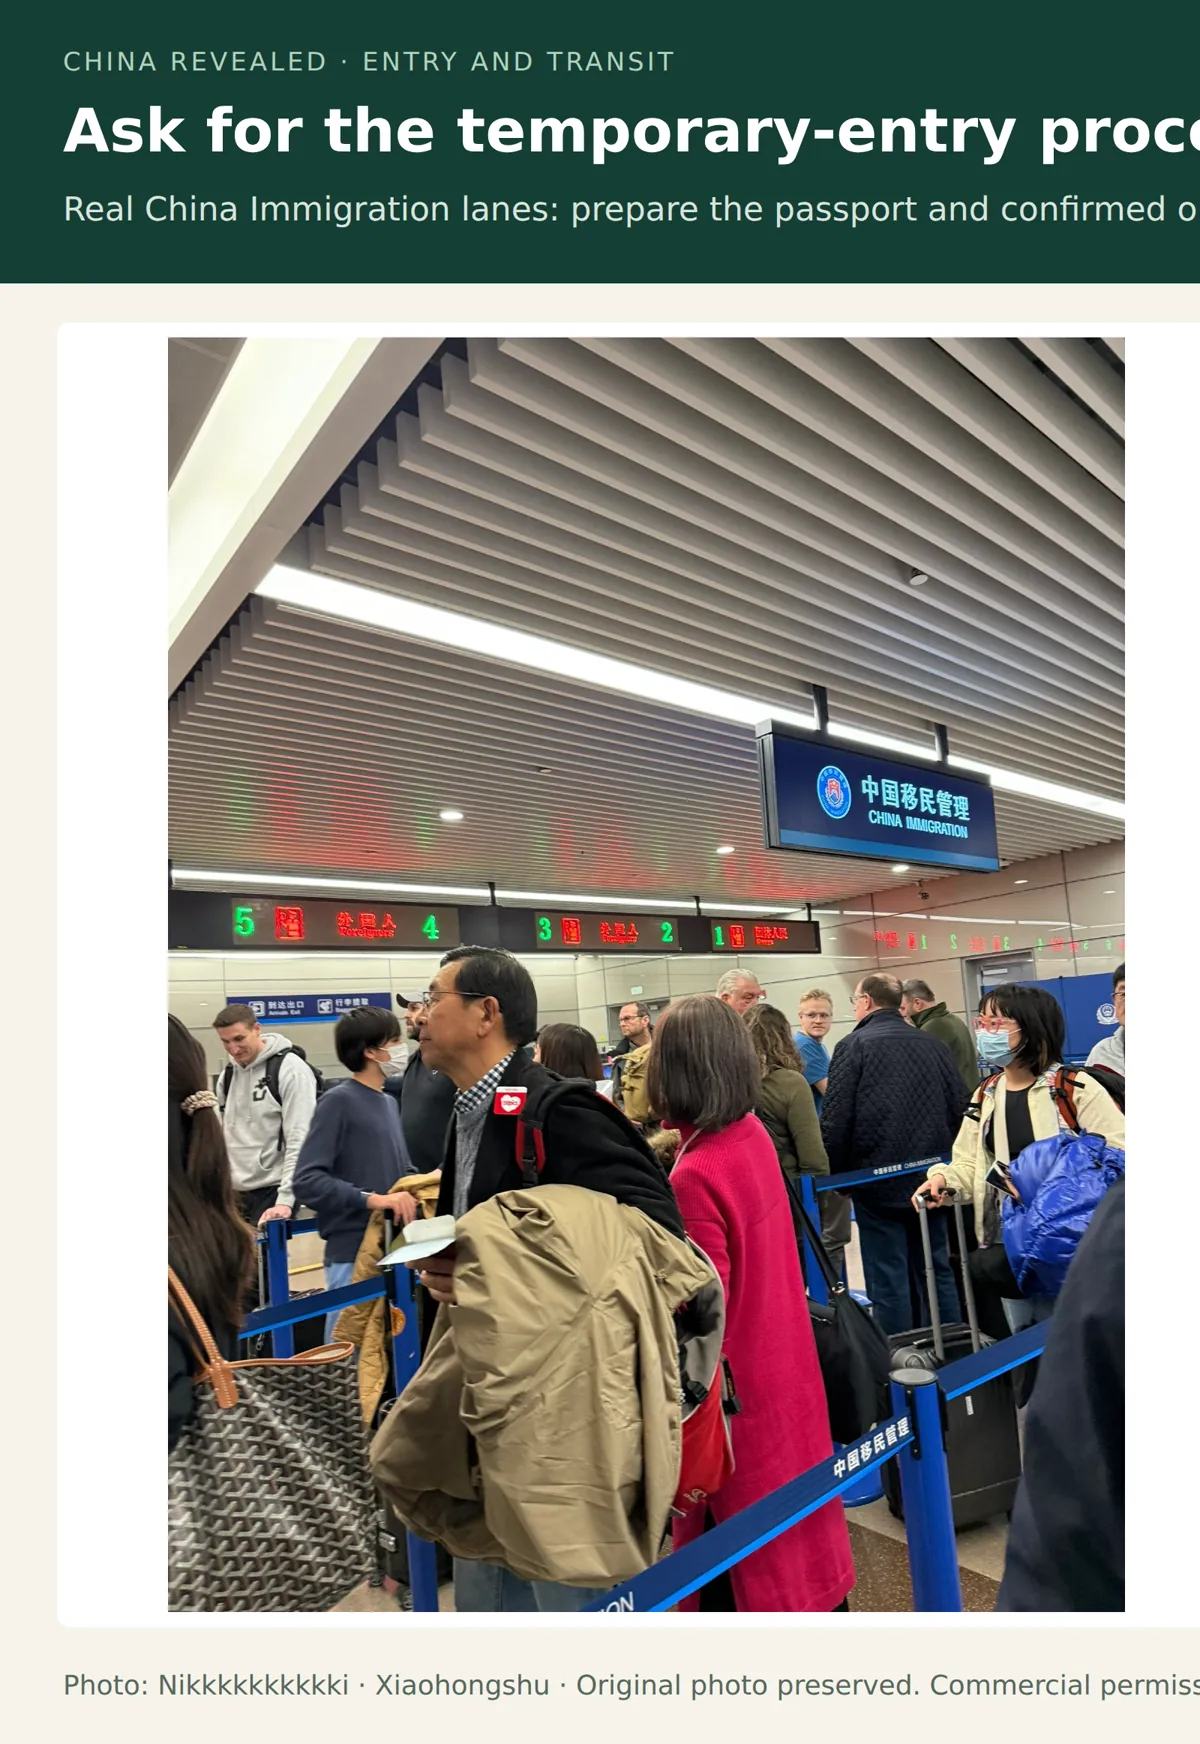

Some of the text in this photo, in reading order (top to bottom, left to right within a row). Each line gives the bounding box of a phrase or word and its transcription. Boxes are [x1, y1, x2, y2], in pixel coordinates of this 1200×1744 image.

[861, 775, 970, 821] 中国移民管理
[868, 810, 968, 839] CHINA IMMIGRATION
[235, 906, 255, 936] 5
[337, 911, 396, 929] 外国人
[422, 914, 440, 940] 4
[538, 917, 552, 941] 3
[600, 921, 639, 936] 外国人
[661, 921, 673, 943] 2
[714, 926, 725, 946] 1
[833, 1416, 910, 1478] 中国移民管理
